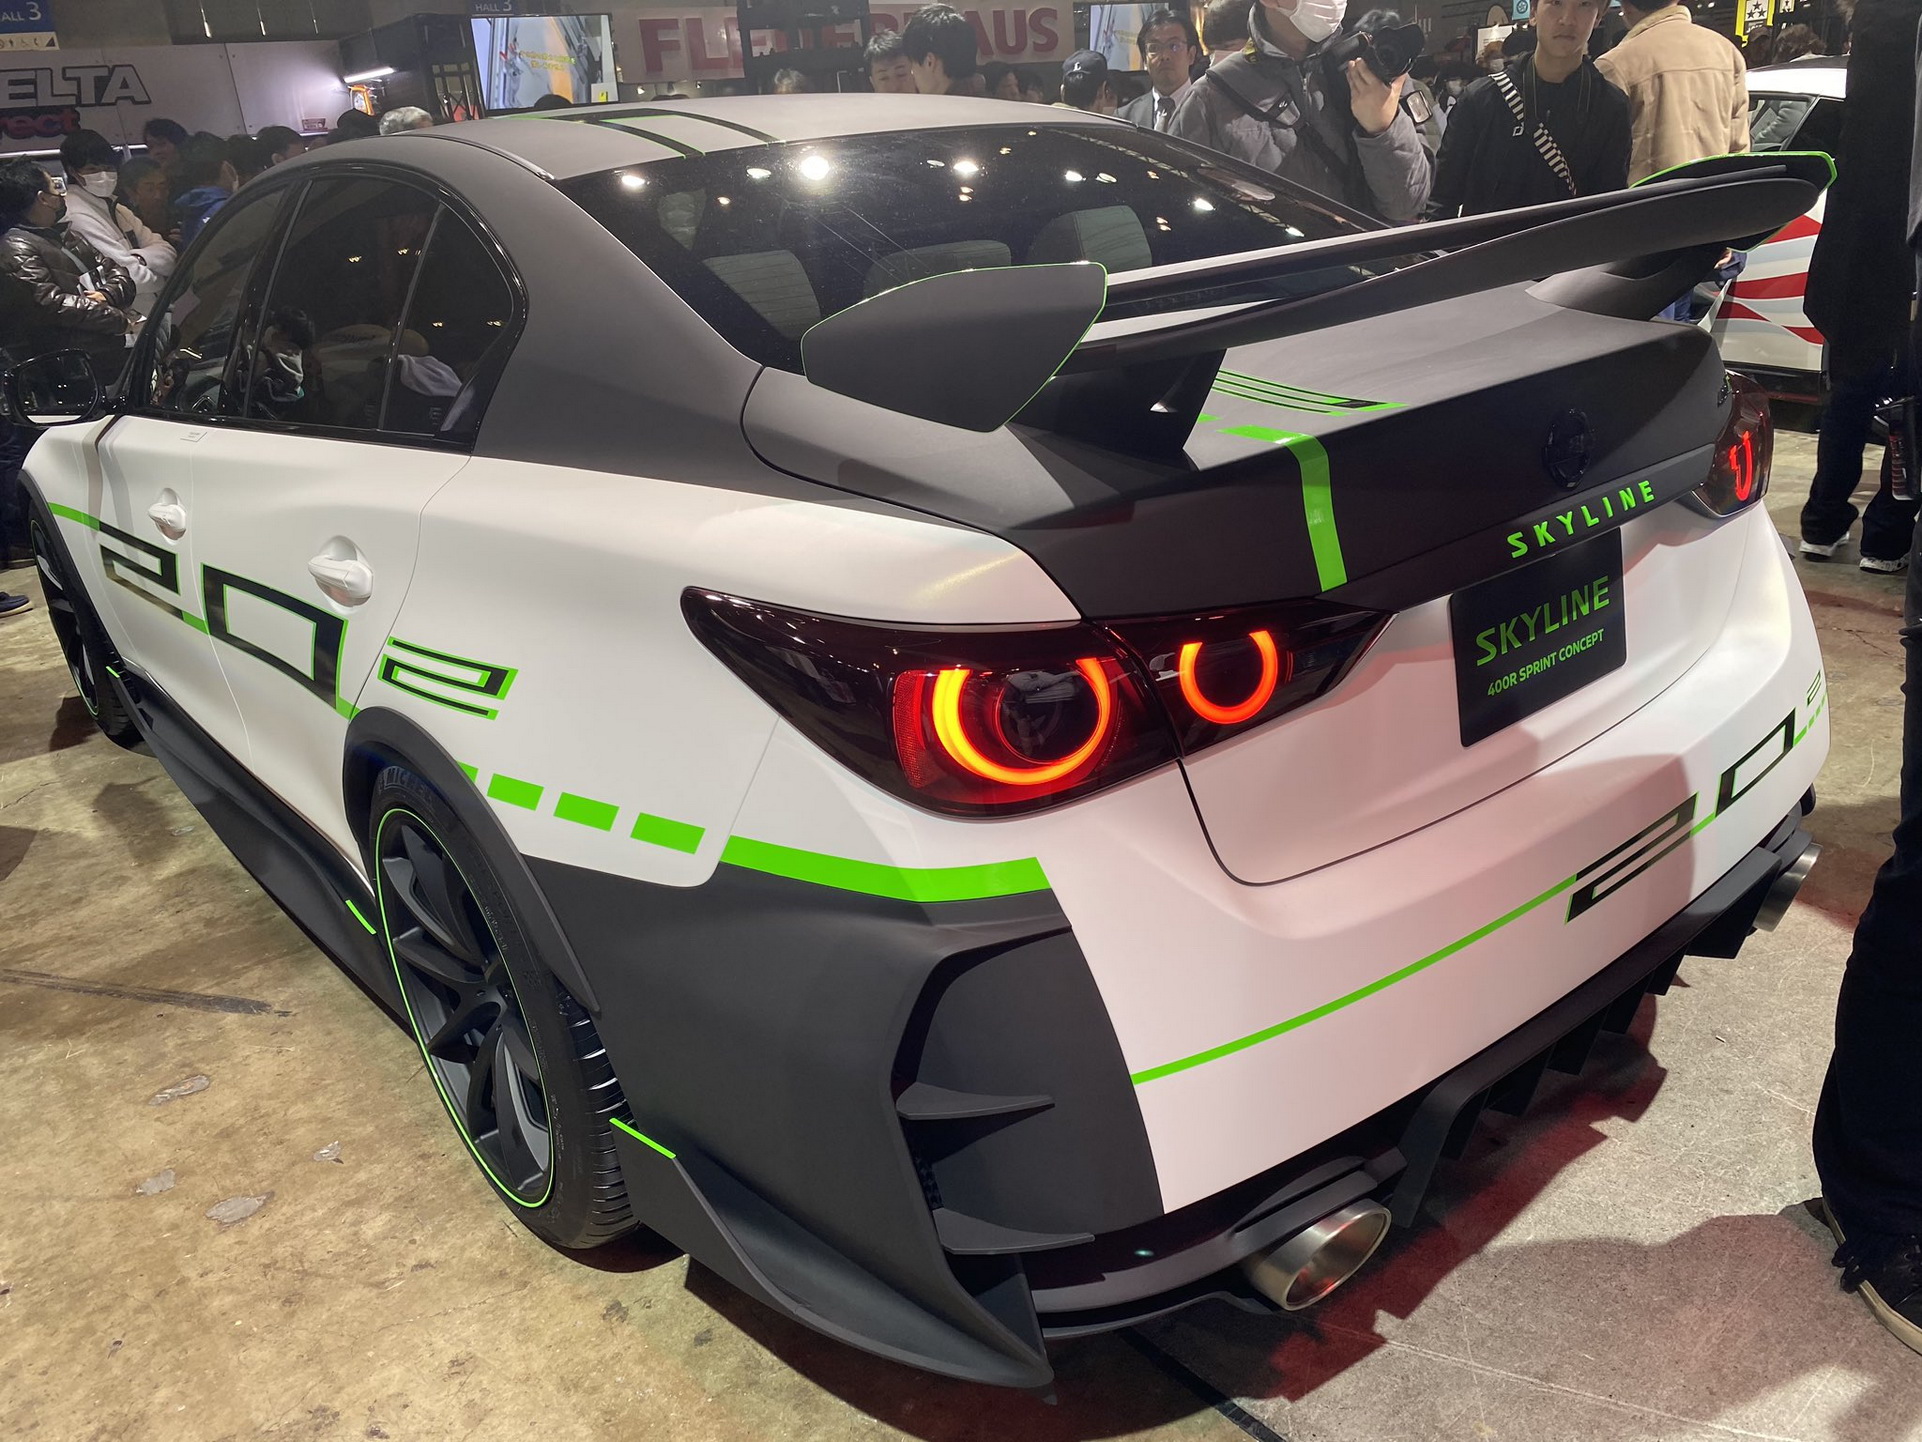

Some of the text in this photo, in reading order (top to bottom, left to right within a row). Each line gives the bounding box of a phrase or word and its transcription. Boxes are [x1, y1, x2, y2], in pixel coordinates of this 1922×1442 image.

[26, 1, 42, 20] 3
[475, 0, 512, 12] HALL 3
[1506, 480, 1655, 559] SKYLINE
[1475, 575, 1610, 667] SKYLINE
[1487, 628, 1605, 697] 400R SPRINT CONCEPT
